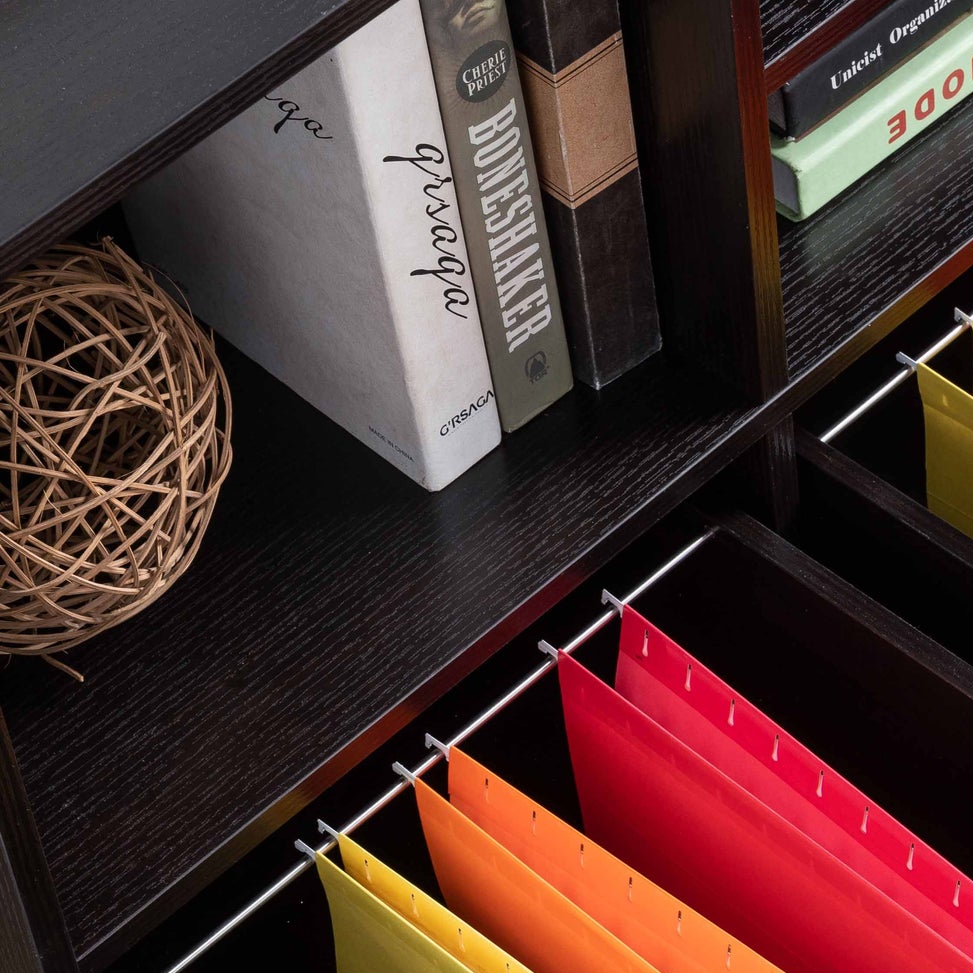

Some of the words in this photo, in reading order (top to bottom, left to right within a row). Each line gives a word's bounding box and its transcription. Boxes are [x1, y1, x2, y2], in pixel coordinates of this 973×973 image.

[462, 47, 506, 84] CHERIE
[830, 43, 882, 90] Unicist
[889, 0, 951, 44] Organiz
[467, 61, 507, 96] PRIEST
[468, 98, 552, 353] BONESHAKER
